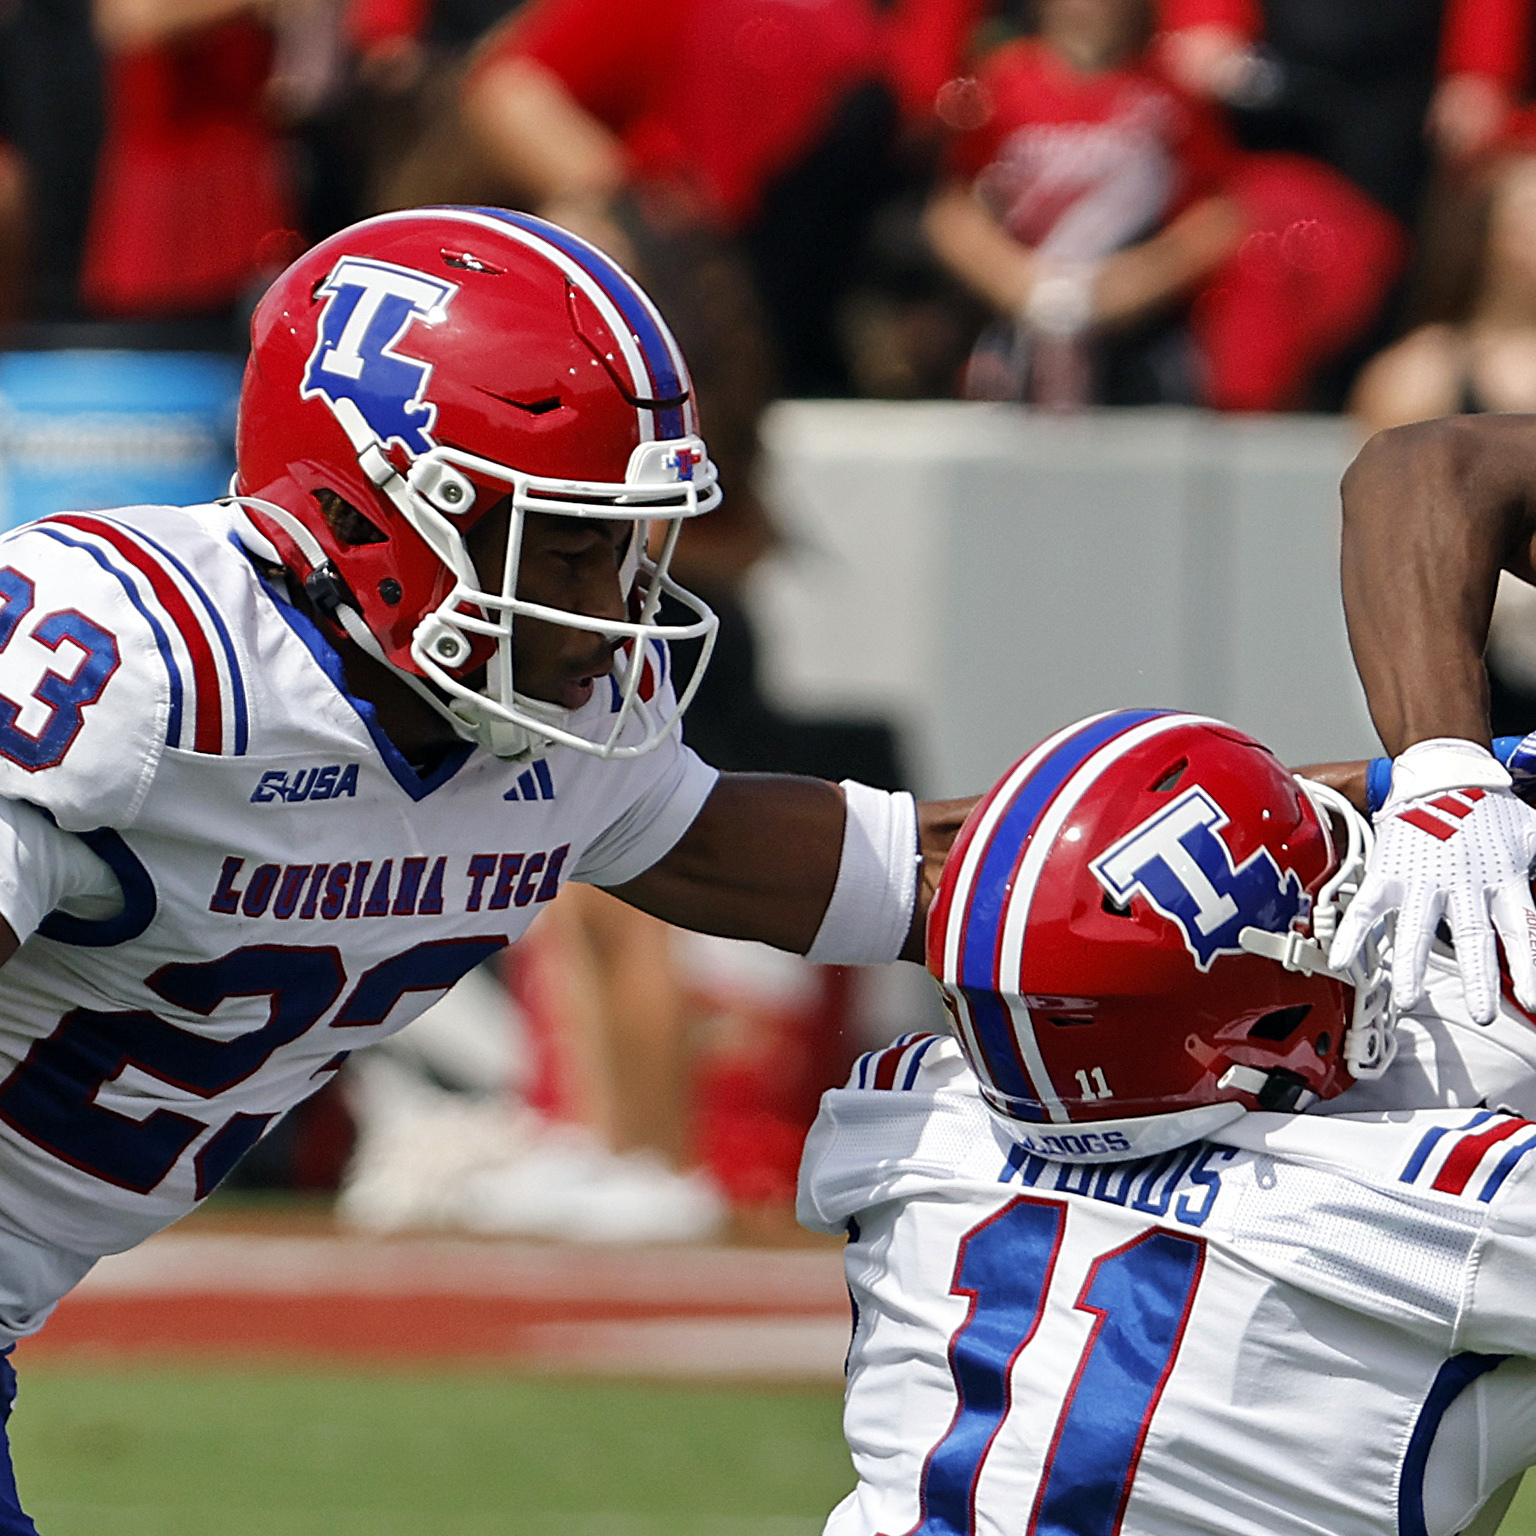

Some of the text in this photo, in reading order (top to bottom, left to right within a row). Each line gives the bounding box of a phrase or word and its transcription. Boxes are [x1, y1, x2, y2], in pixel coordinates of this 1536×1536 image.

[209, 843, 571, 920] LOUISIANA TECH
[1074, 1066, 1114, 1101] 11
